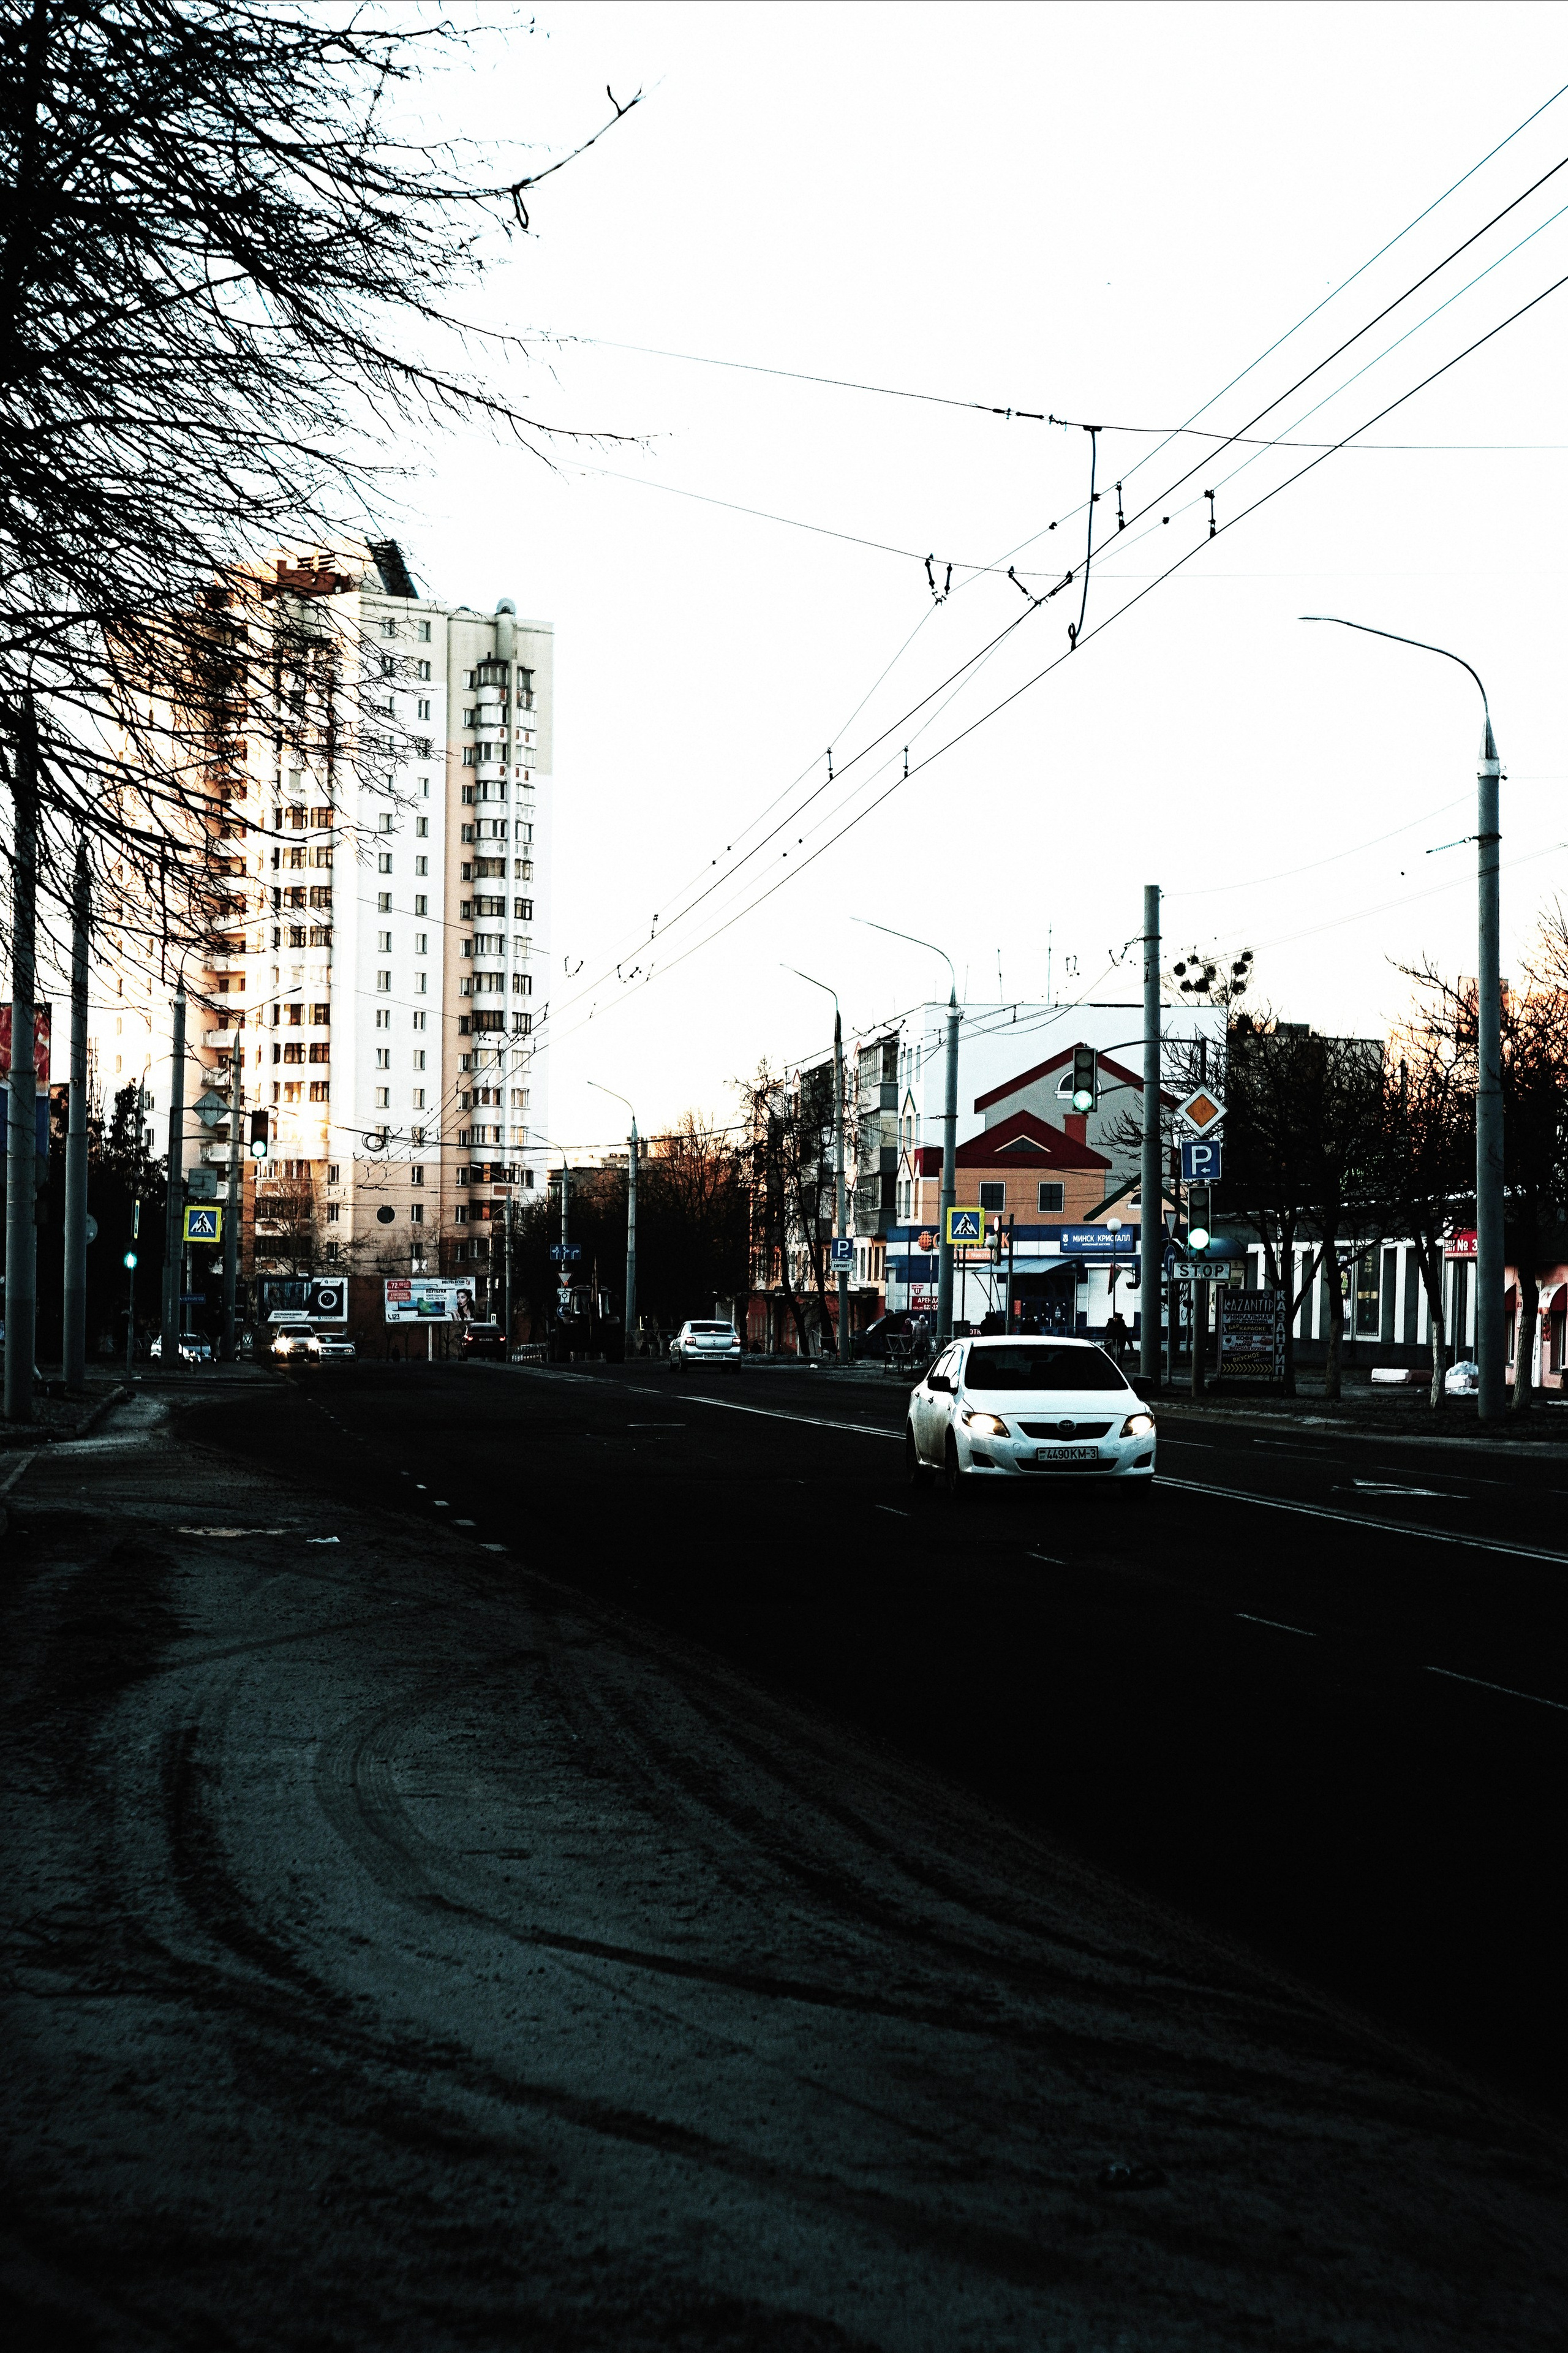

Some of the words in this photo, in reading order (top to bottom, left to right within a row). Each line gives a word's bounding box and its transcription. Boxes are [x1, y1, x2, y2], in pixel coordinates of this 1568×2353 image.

[1191, 1146, 1212, 1175] P
[837, 1241, 850, 1257] P
[1179, 1264, 1224, 1277] STOP
[1224, 1299, 1274, 1312] KAZANTIP
[1275, 1290, 1286, 1375] КАЗАНТИП
[1232, 1351, 1261, 1363] ВКУСНОЕ
